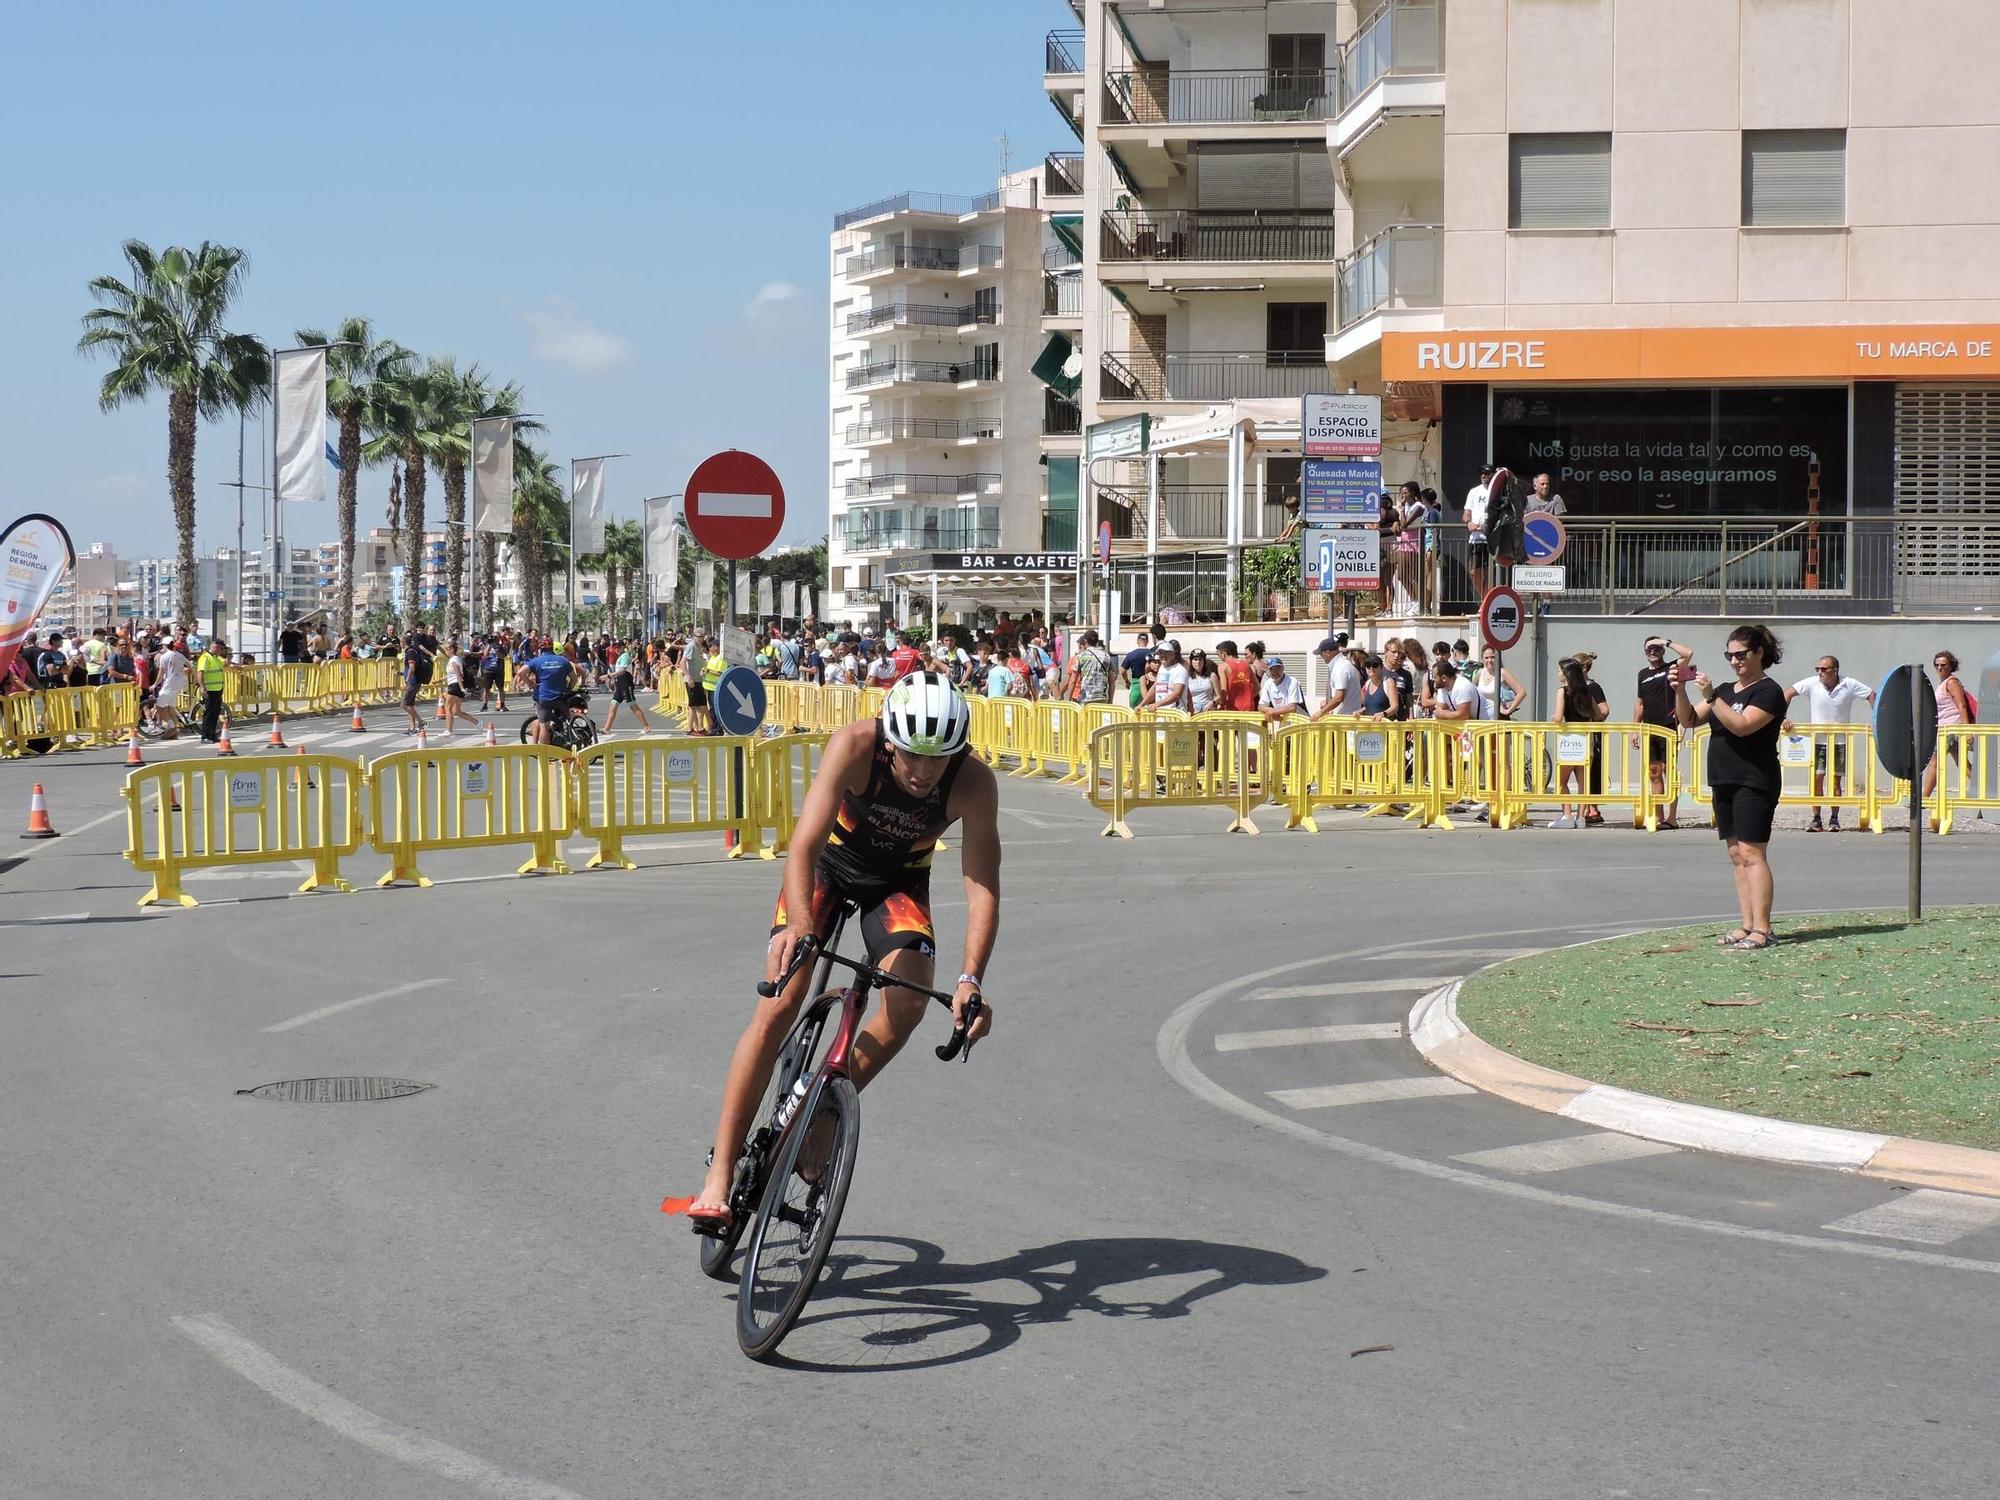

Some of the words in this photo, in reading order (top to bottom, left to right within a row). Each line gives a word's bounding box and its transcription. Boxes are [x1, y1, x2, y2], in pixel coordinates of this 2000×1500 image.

[1418, 341, 1545, 369] RUIZRE
[1856, 342, 1881, 358] TU
[1889, 341, 1958, 358] MARCA
[1966, 341, 1992, 357] DE
[1319, 416, 1369, 427] ESPACIO
[1309, 428, 1378, 438] DISPONIBLE
[1529, 441, 1565, 457] Nos
[1569, 442, 1620, 461] gusta
[1626, 441, 1641, 457] la
[1646, 441, 1684, 457] vida
[1689, 441, 1710, 457] tal
[1715, 445, 1727, 461] y
[1732, 445, 1783, 457] como
[1308, 469, 1346, 478] Quesada
[1348, 469, 1379, 478] Market
[1561, 467, 1594, 482] Por
[1599, 470, 1632, 482] eso
[1638, 467, 1654, 482] la
[1660, 469, 1777, 485] aseguramos
[11, 548, 38, 560] REGIÓN
[1319, 550, 1367, 560] ACIO
[9, 556, 19, 564] DE
[20, 559, 47, 571] MURCIA
[961, 556, 995, 567] BAR
[1013, 556, 1077, 567] CAFETE
[1308, 562, 1376, 572] DIONIBLE
[867, 816, 920, 839] BLANCO
